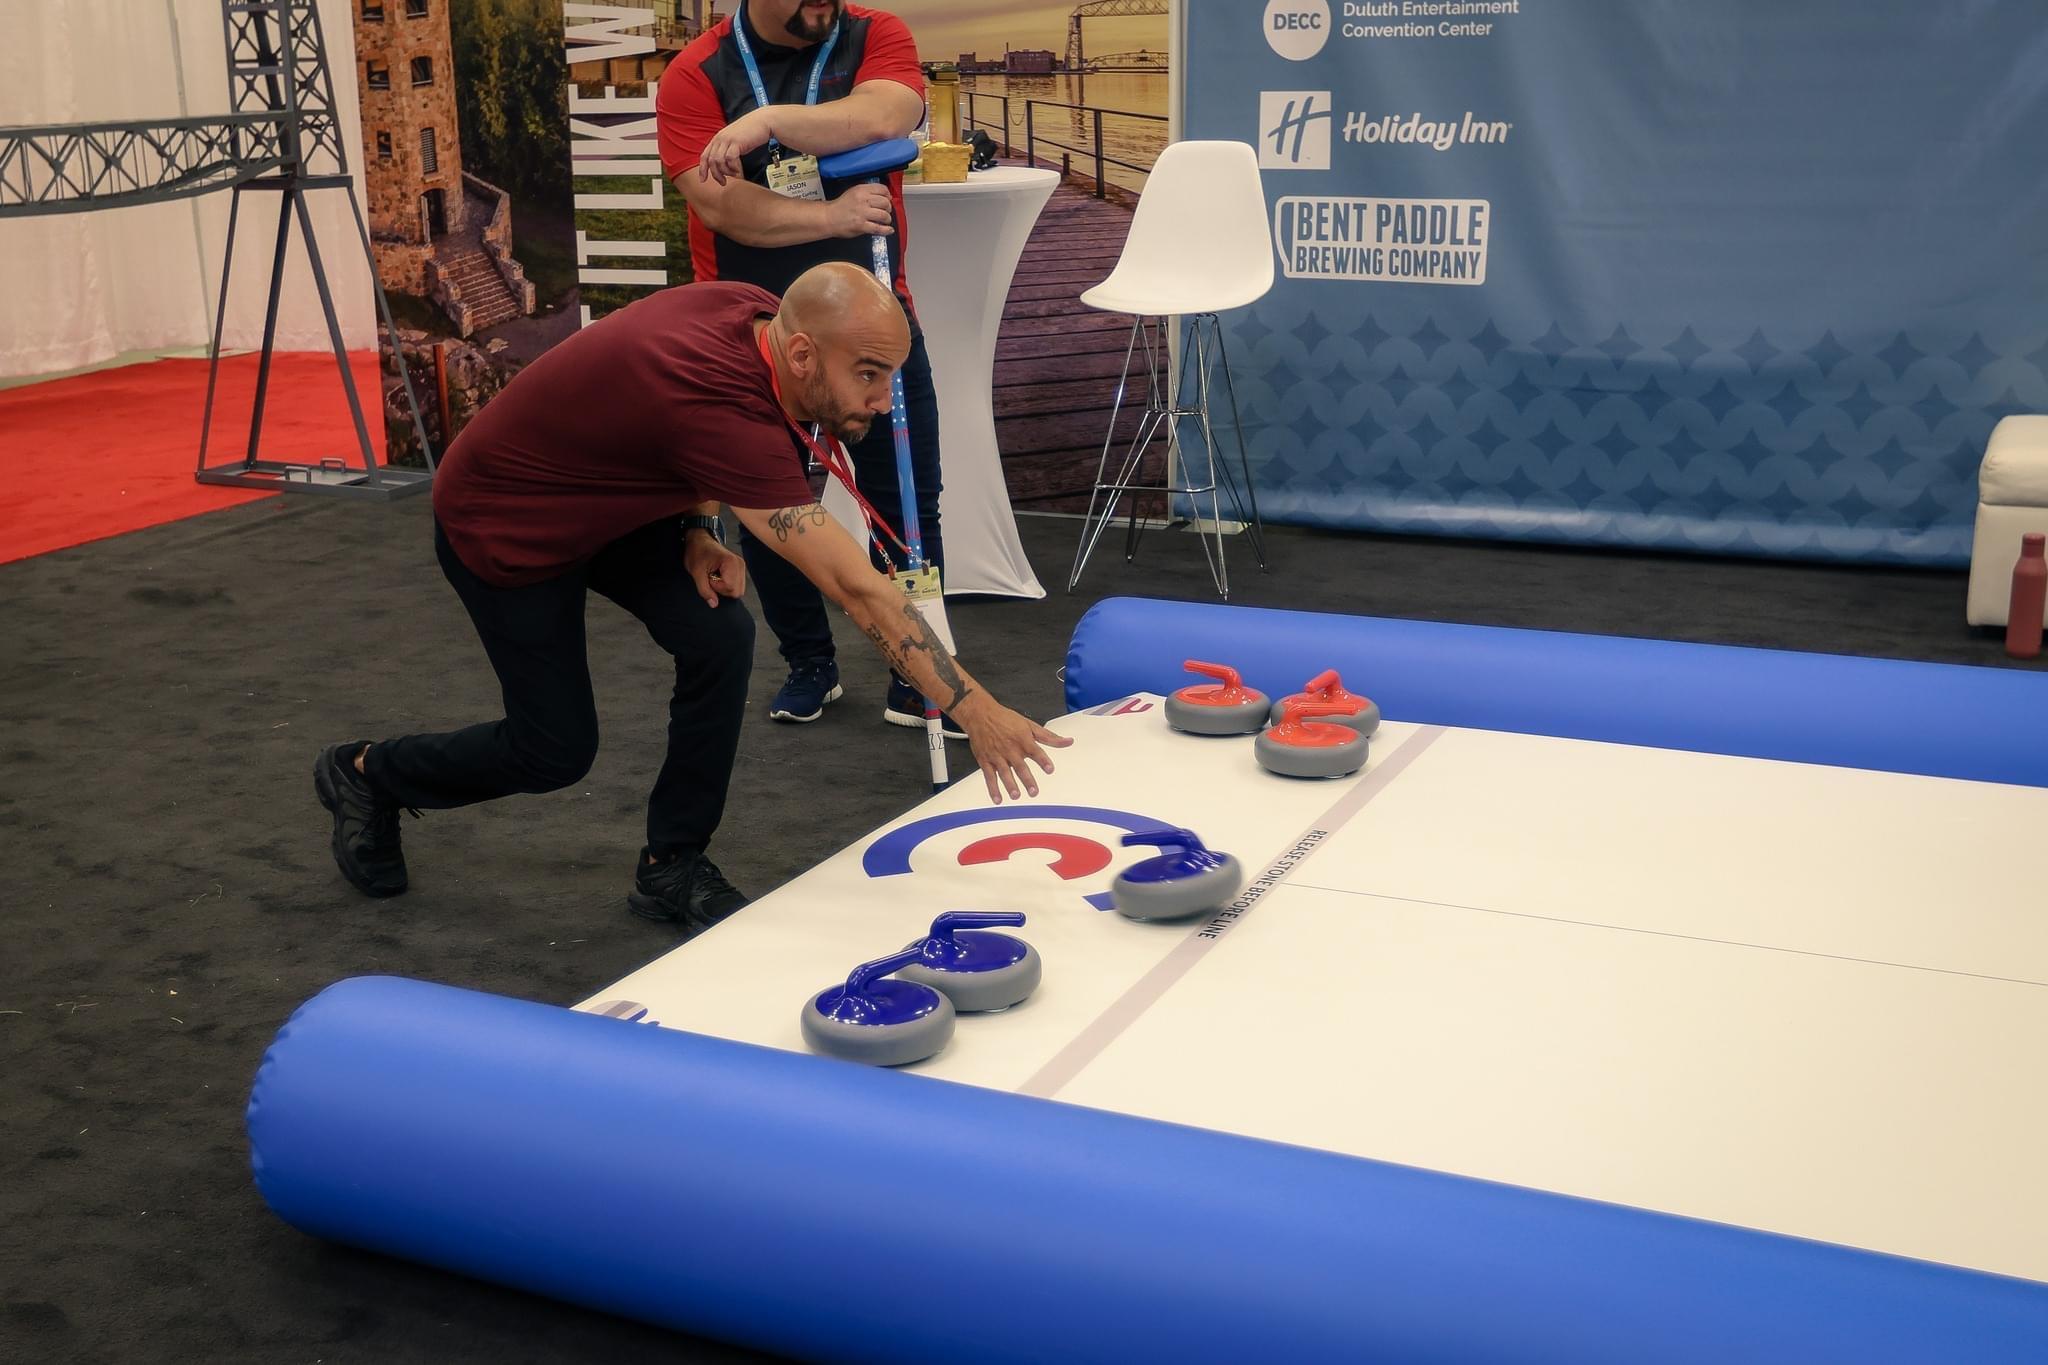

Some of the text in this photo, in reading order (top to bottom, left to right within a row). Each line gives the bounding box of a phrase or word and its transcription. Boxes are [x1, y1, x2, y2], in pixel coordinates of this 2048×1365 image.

[1273, 13, 1321, 31] DECC
[1343, 0, 1519, 17] Duluth Entertainment
[1342, 22, 1493, 38] Convention Center
[568, 82, 664, 209] LIKE
[1343, 112, 1510, 151] Holiday Inn
[787, 181, 807, 191] JASON
[1296, 202, 1484, 246] BENT PADDLE
[576, 230, 667, 285] IT
[1295, 246, 1481, 279] BREWING COMPANY
[1198, 830, 1328, 940] RELEASE STONE BEFORE LINE
